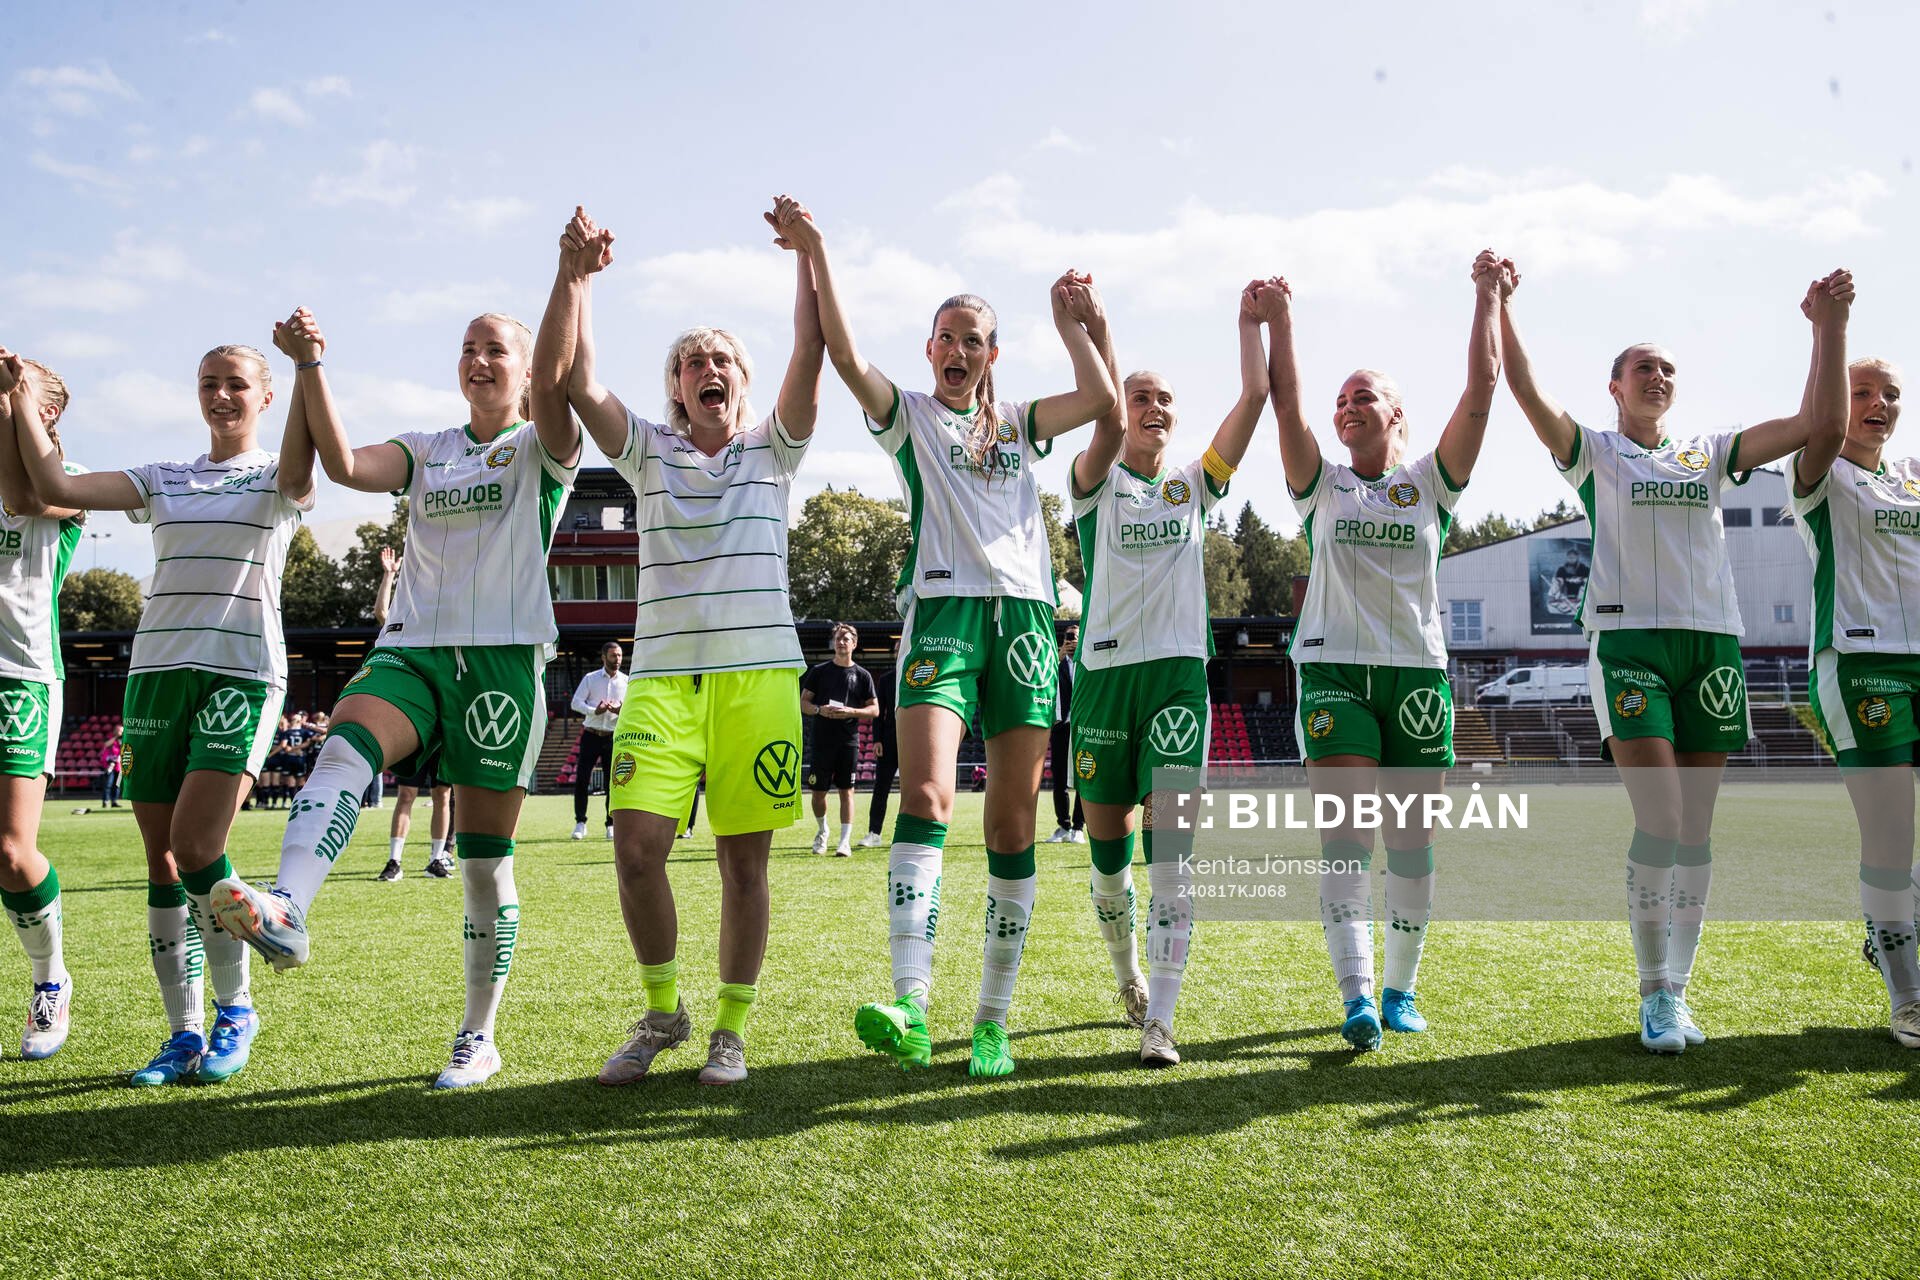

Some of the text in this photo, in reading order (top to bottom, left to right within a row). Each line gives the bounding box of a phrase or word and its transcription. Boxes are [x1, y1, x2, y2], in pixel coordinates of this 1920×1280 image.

[424, 483, 502, 511] PROJOB
[1632, 482, 1709, 501] PROJOB
[1678, 501, 1709, 509] WORKWEAR
[426, 504, 502, 519] PROFESSIONAL WORKWEAR
[1335, 519, 1416, 542] PROJOB
[1122, 541, 1164, 550] PROFESSIONAL
[1335, 538, 1414, 550] PROFESSIONAL WORKWEAR
[920, 635, 974, 653] OSPHORUS
[7, 747, 36, 757] CRAFT
[207, 742, 237, 752] CRAFT
[1421, 745, 1446, 754] CRAFT
[480, 758, 508, 769] CRAFT
[1164, 763, 1189, 772] CRAFT
